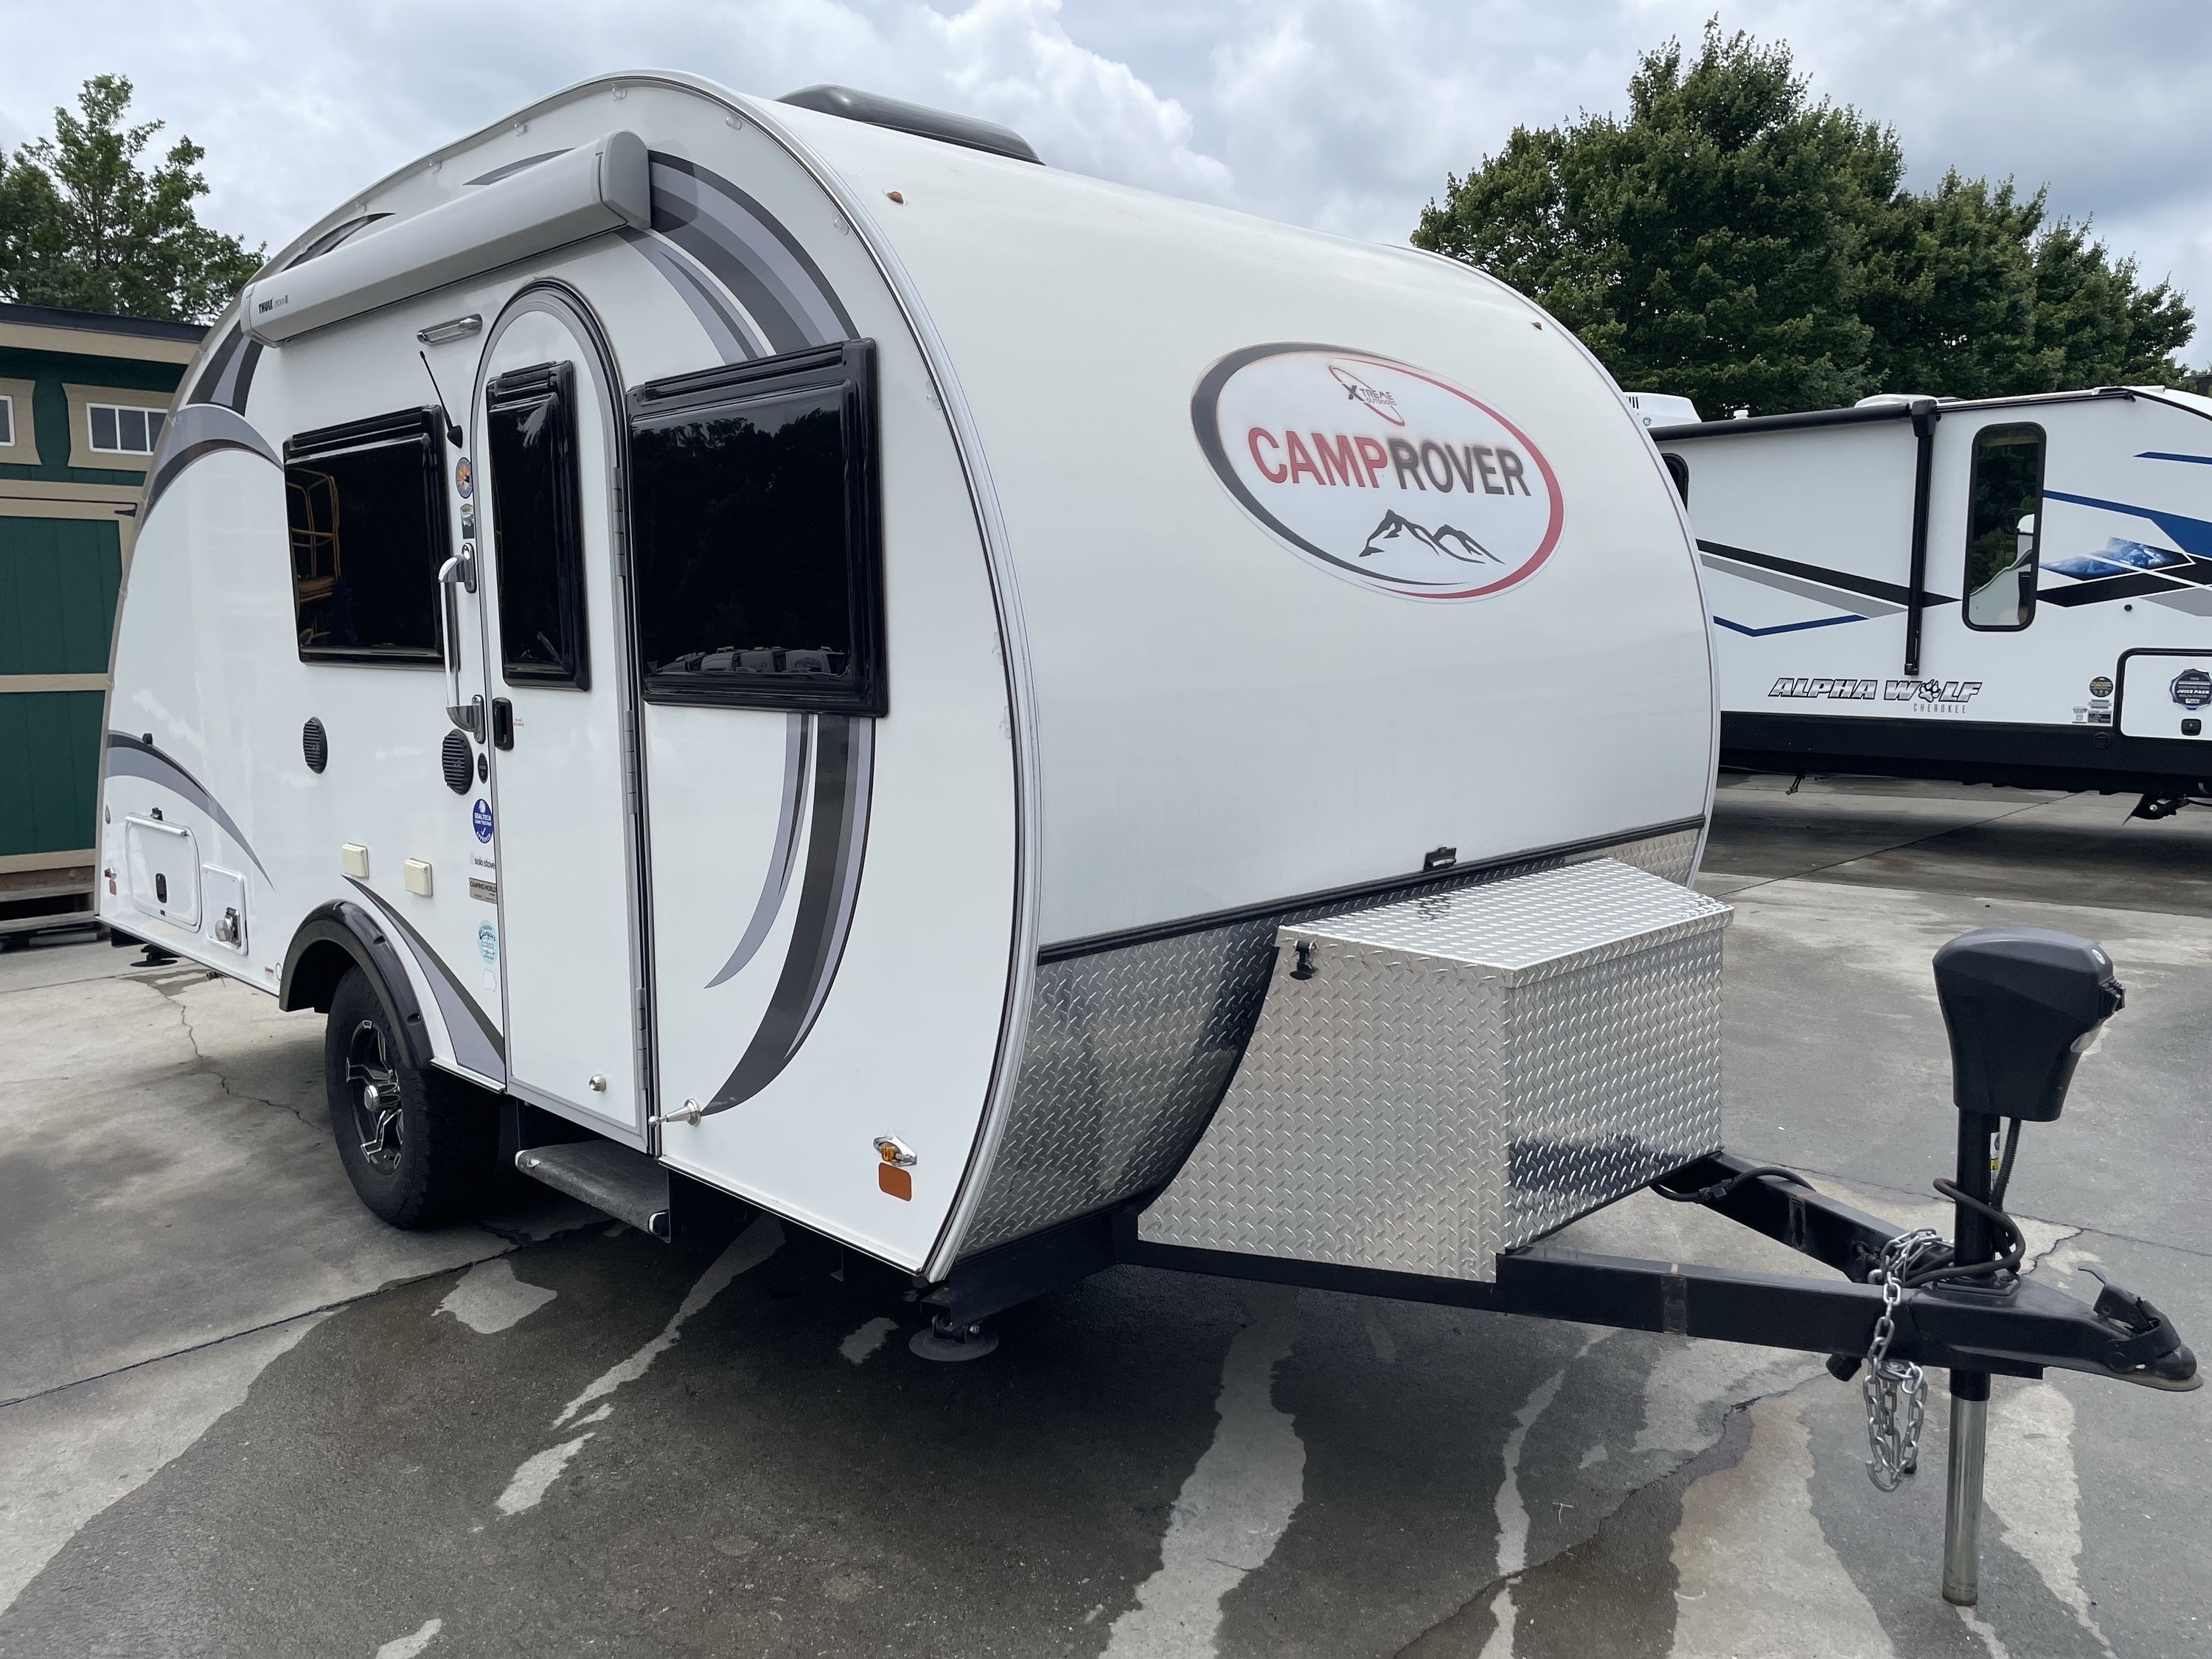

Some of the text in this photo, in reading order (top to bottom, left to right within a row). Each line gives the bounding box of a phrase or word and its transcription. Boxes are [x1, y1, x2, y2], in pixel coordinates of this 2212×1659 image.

[259, 299, 274, 314] THULE
[1342, 385, 1394, 401] XTREME
[1366, 397, 1397, 406] OUTDOORS
[1247, 426, 1531, 497] CAMPROVER
[1768, 678, 1879, 700] ALPHA
[1913, 703, 1967, 714] CHEROKEE
[474, 858, 484, 866] solo
